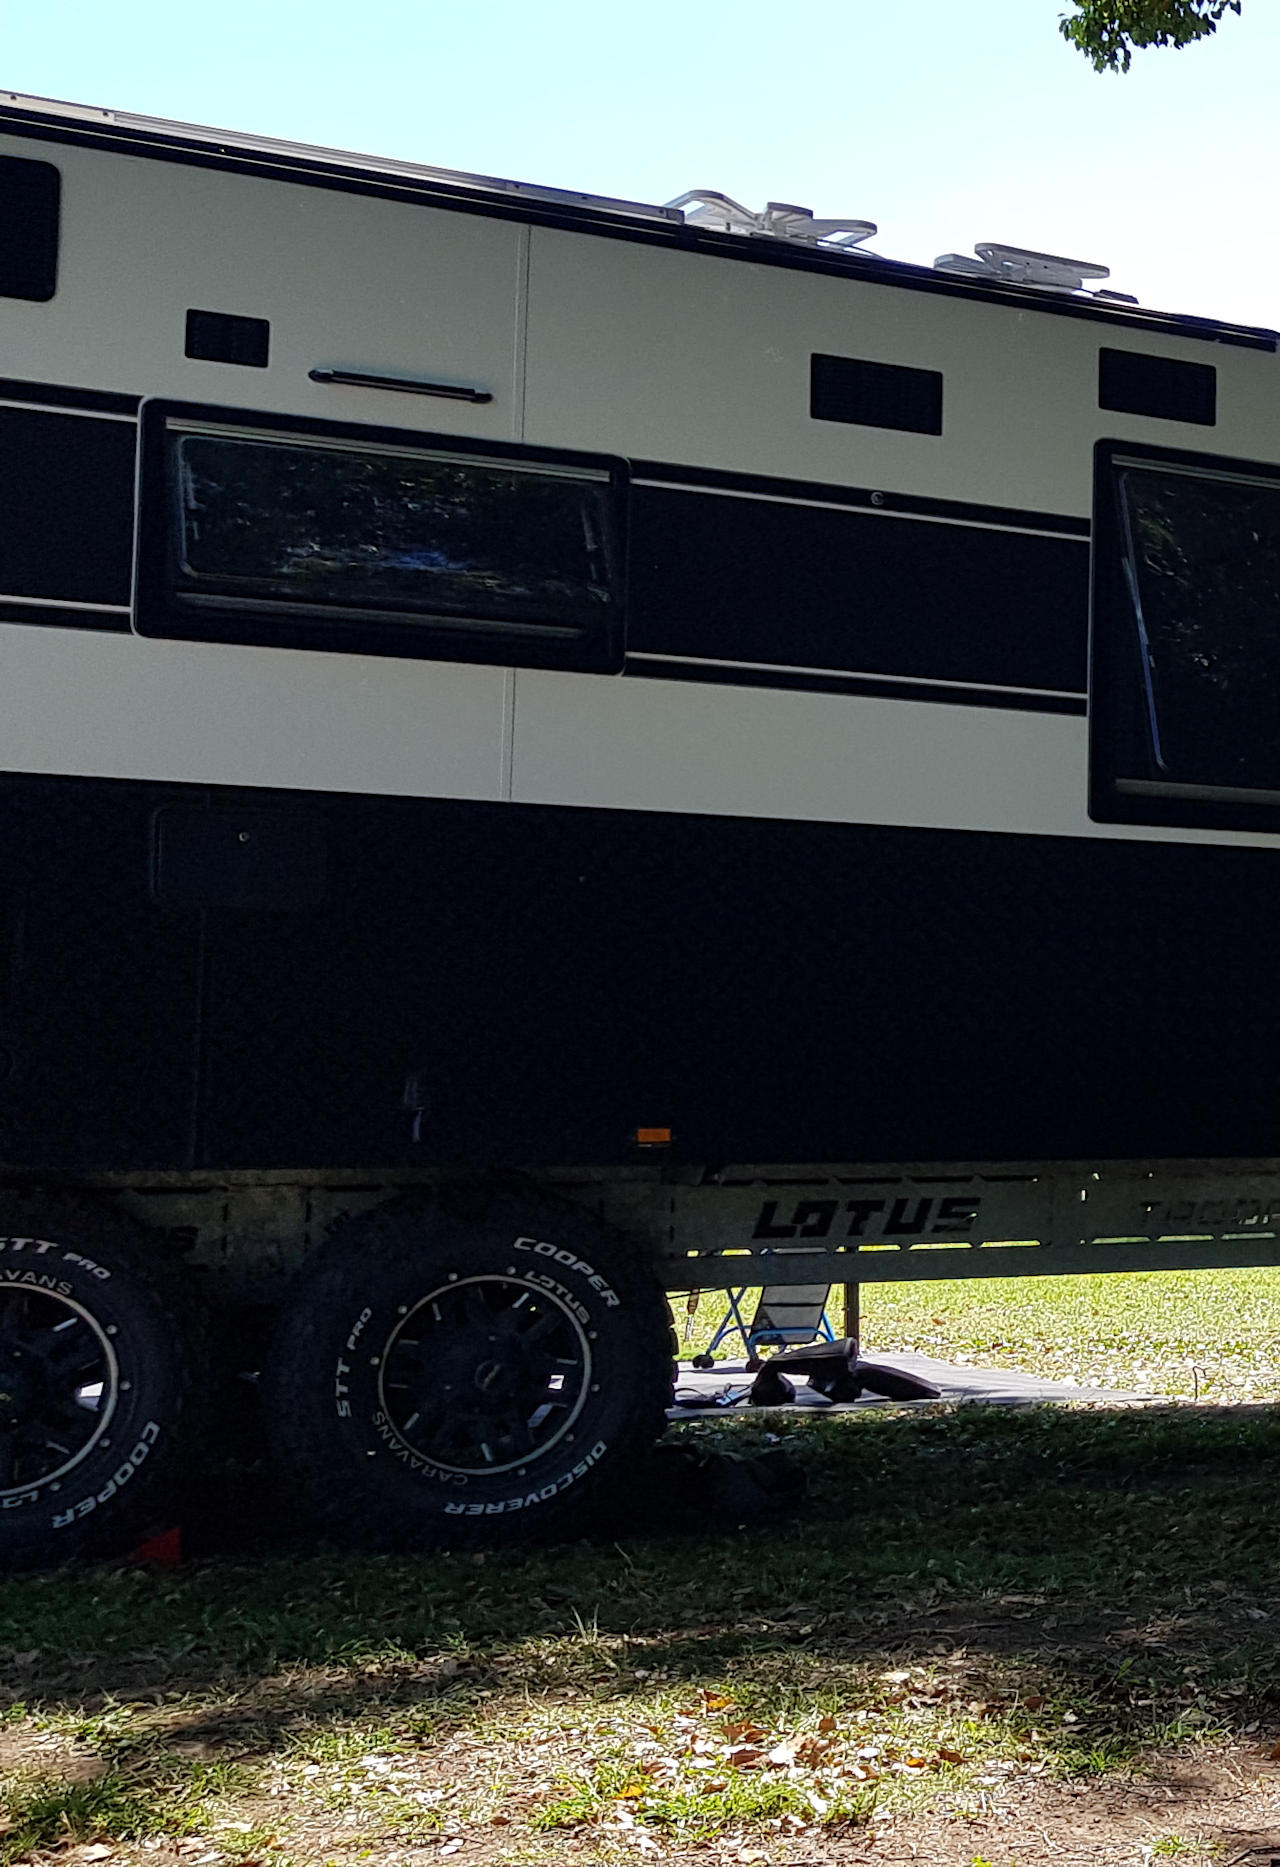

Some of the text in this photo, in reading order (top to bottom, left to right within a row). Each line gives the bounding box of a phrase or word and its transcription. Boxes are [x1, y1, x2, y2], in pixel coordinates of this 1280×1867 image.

[752, 1197, 981, 1239] LOTUS
[62, 1251, 113, 1281] PRO
[513, 1235, 621, 1308] COOPER
[523, 1269, 593, 1325] LOTUS
[334, 1306, 373, 1418] STT PRO
[50, 1420, 161, 1529] COOPER
[371, 1410, 469, 1487] CARAVANS
[443, 1439, 608, 1516] DISCOVERER
